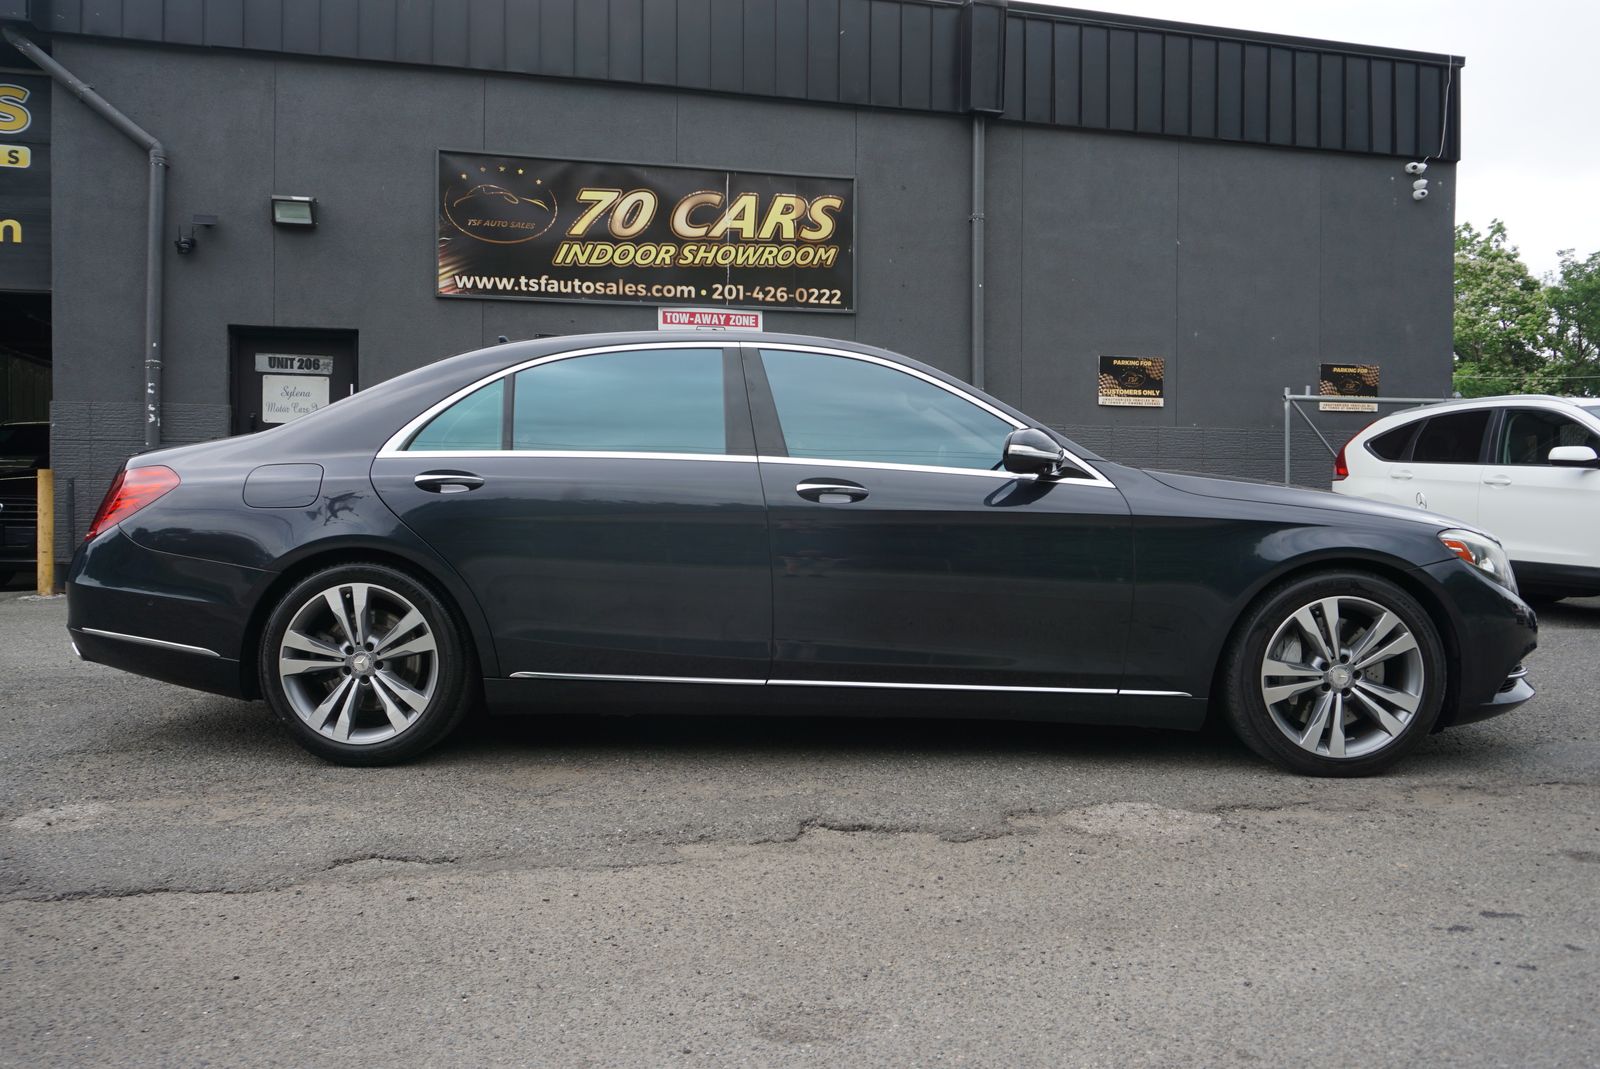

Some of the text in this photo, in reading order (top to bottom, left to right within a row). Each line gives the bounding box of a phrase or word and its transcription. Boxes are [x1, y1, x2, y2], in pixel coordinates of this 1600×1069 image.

[566, 187, 845, 244] 70 CARS
[467, 218, 536, 230] TSF AUTO SALES
[552, 241, 839, 269] INDOOR SHOWROOM
[454, 274, 842, 306] www.tsfautosales.com 201-426-0222
[665, 312, 756, 326] TOW-AWAY ZONE
[268, 356, 321, 370] UNIT 206
[265, 401, 290, 413] Motor
[291, 402, 310, 413] Cars
